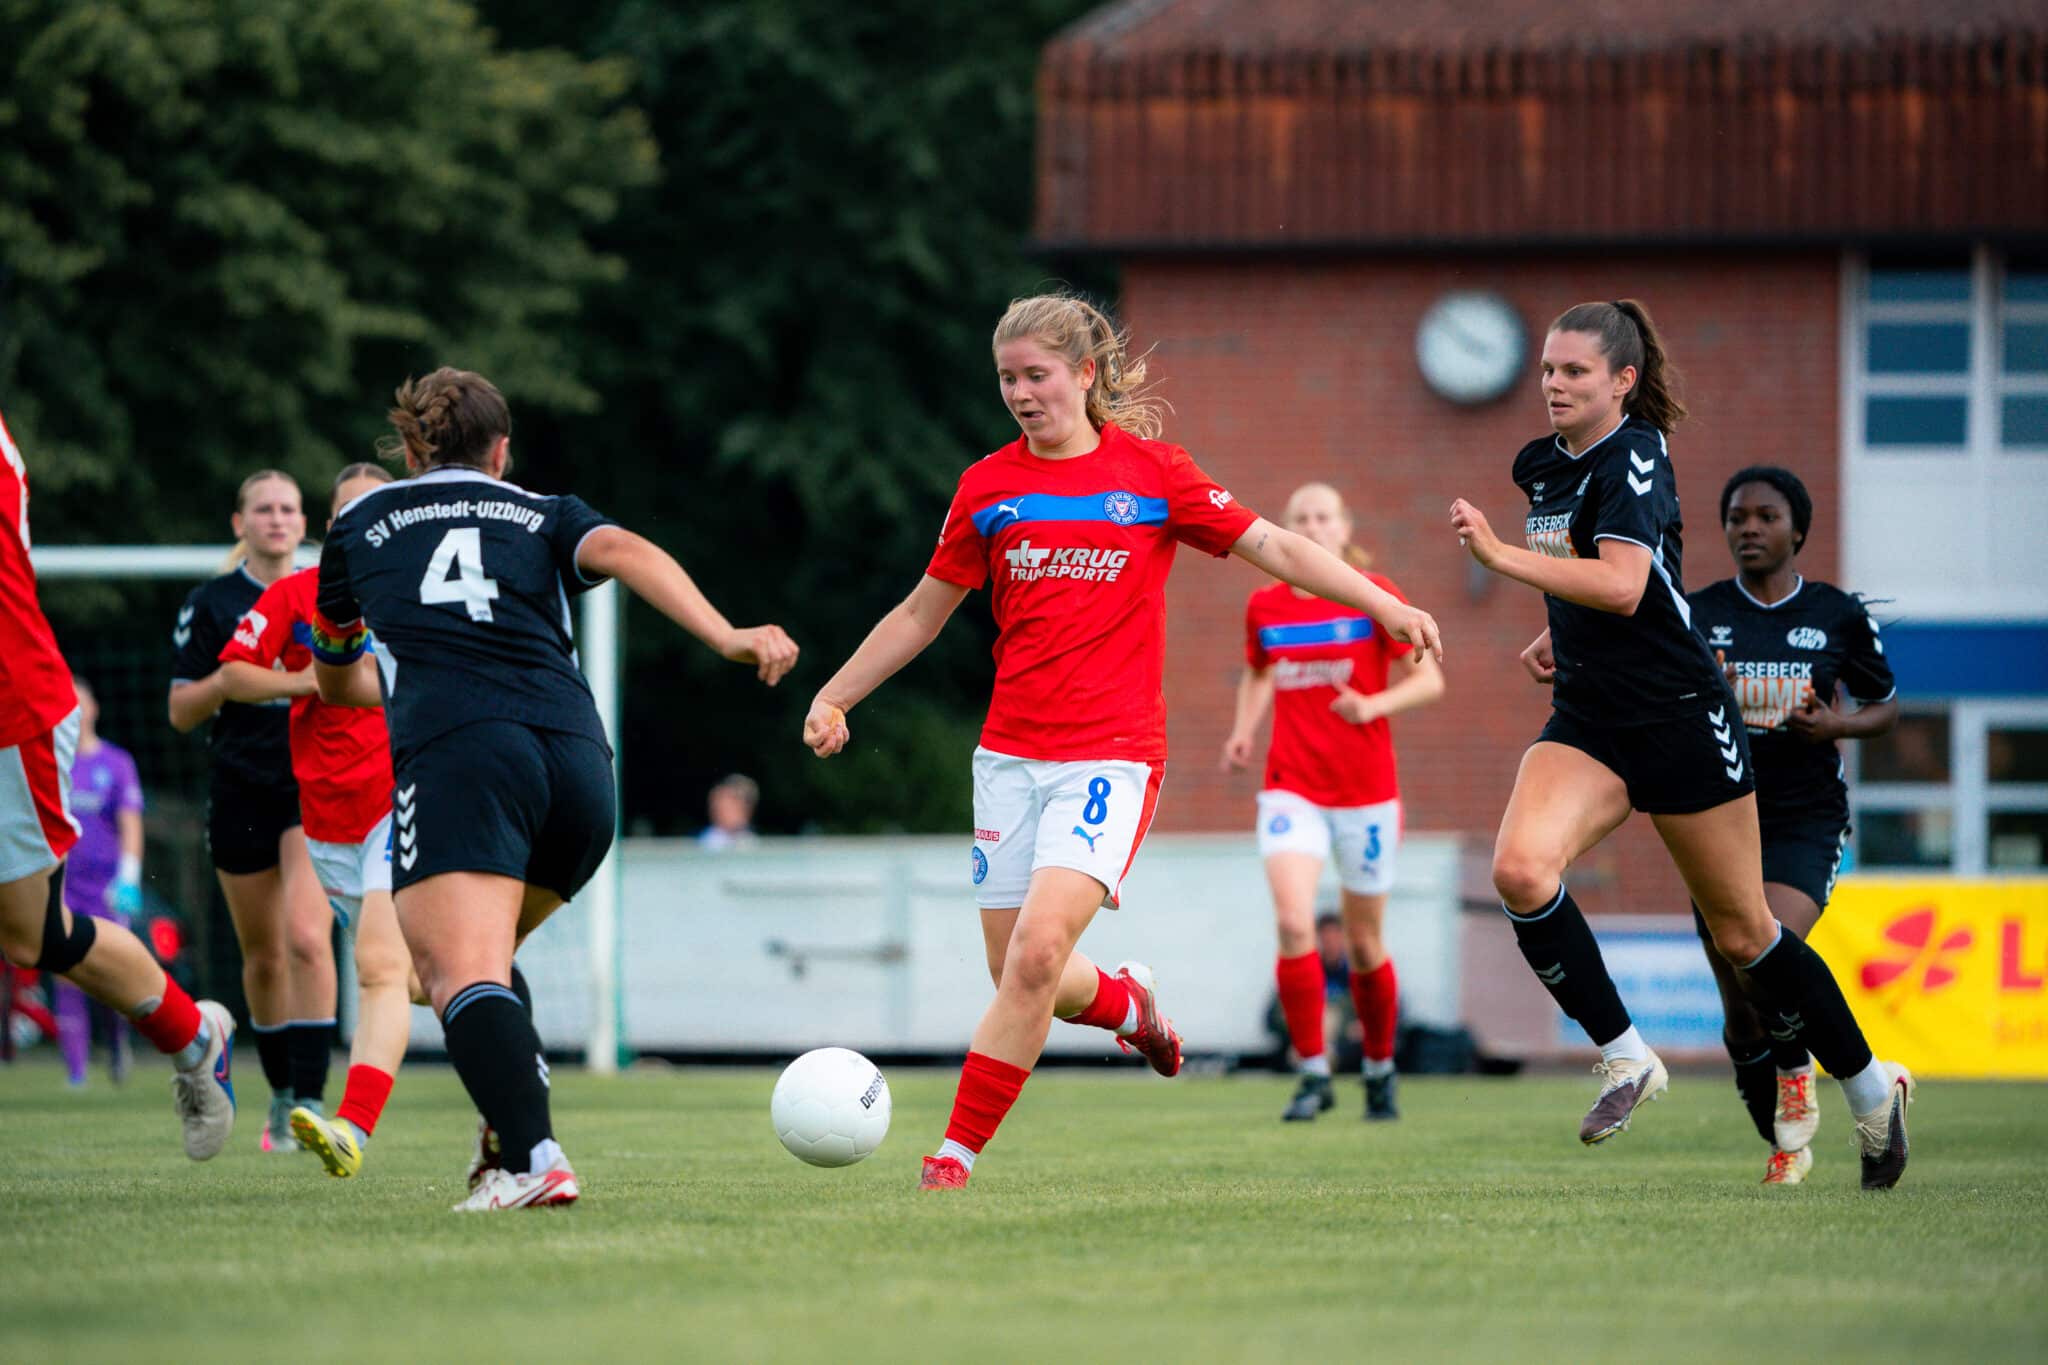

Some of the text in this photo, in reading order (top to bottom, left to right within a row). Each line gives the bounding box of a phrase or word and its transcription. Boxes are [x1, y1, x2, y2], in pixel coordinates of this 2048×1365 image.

[365, 500, 545, 548] SV Henstedt-Ulzburg
[420, 527, 498, 622] 4
[1010, 565, 1120, 582] TRANSPORTE
[1051, 548, 1130, 569] KRUG
[1722, 661, 1812, 679] ESEBECK
[1082, 776, 1111, 825] 8
